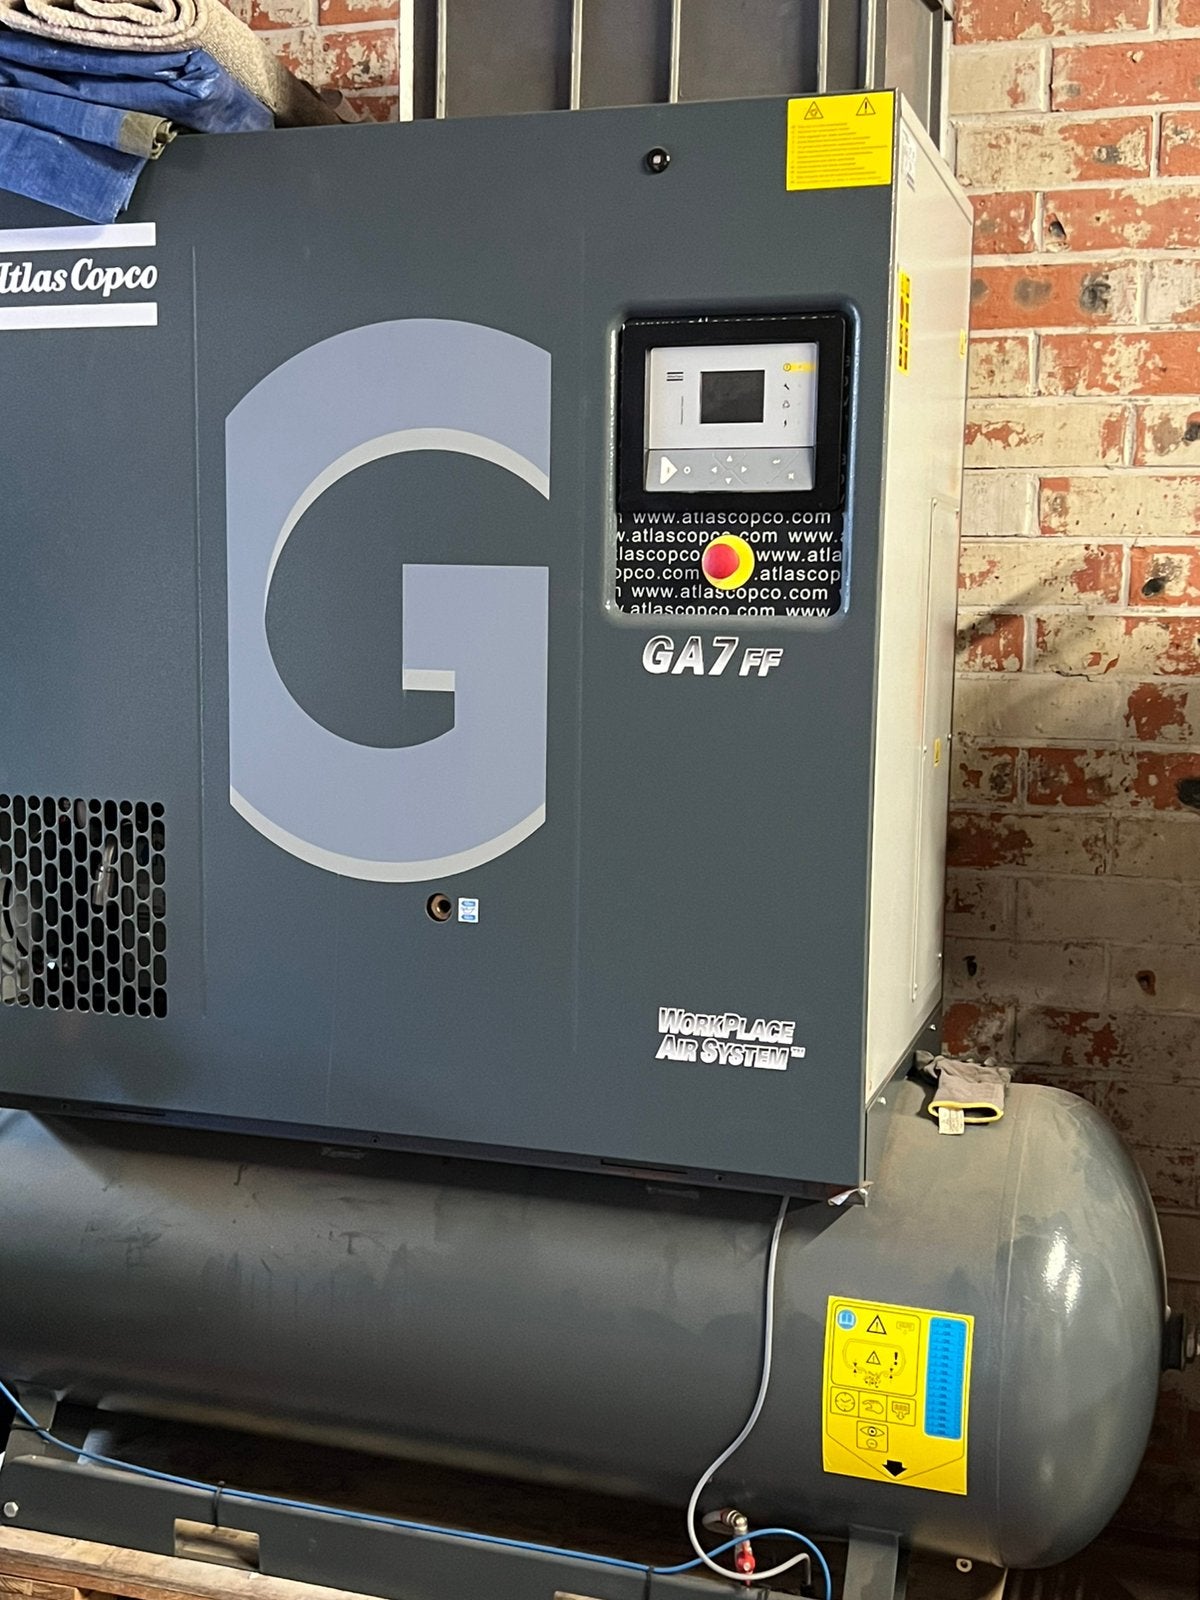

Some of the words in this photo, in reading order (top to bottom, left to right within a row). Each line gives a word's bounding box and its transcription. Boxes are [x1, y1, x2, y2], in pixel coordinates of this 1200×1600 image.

[70, 257, 158, 297] Copco
[633, 512, 831, 528] www.atlascopco.com
[616, 546, 700, 565] lascopco
[225, 317, 551, 883] G
[631, 584, 828, 603] www.atlascopco.com
